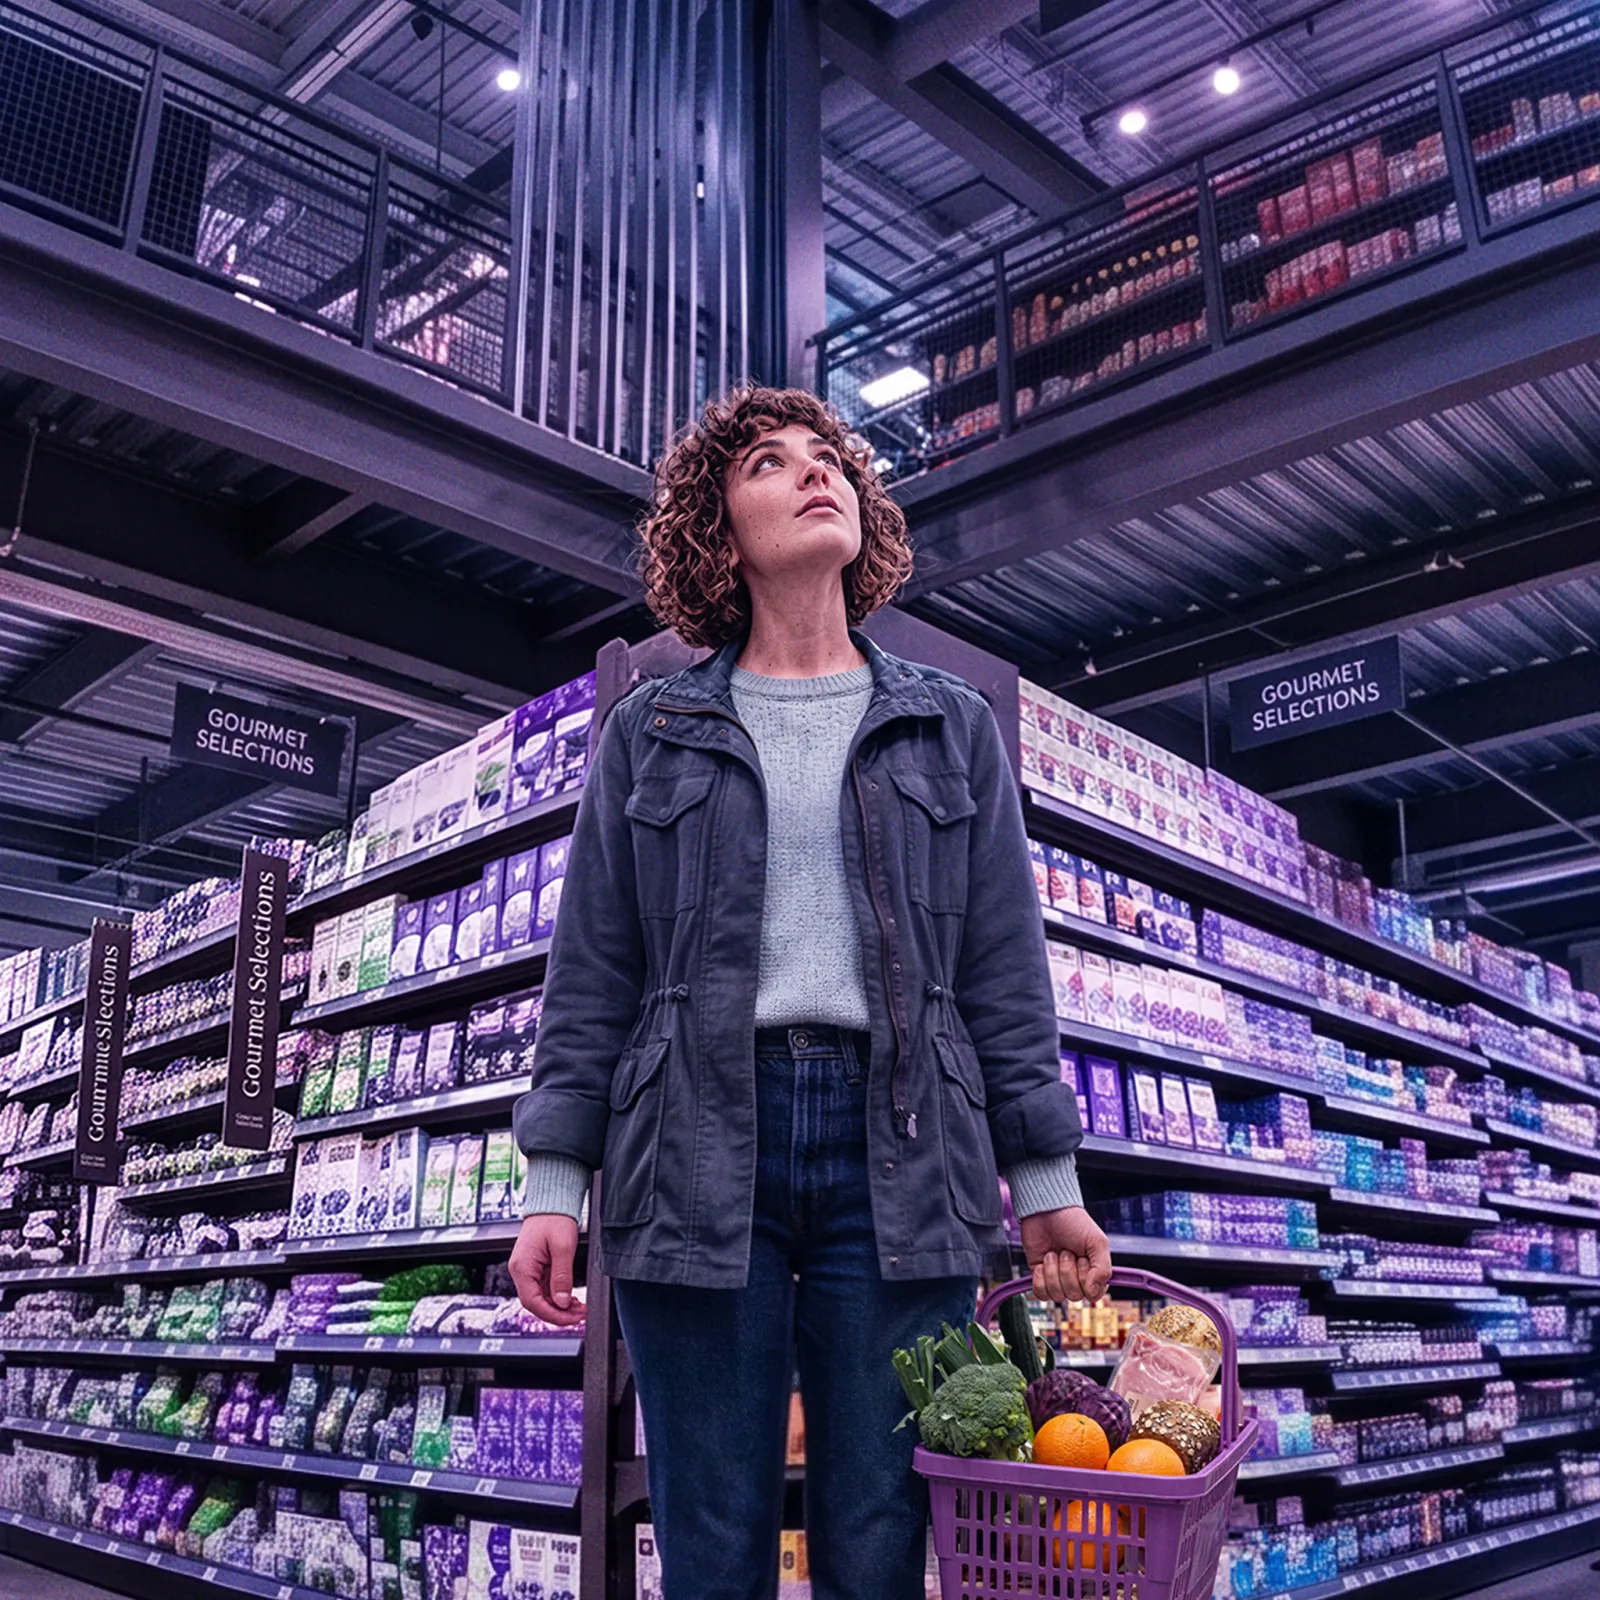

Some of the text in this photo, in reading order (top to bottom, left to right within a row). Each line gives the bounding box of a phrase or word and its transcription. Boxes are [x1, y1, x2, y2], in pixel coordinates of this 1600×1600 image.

[1252, 681, 1381, 732] SELECTIONS
[1261, 659, 1366, 705] GOURMET
[195, 728, 315, 775] SELECTIONS
[207, 708, 308, 750] GOURMET
[247, 870, 275, 993] Selections
[242, 998, 267, 1098] Gourmet
